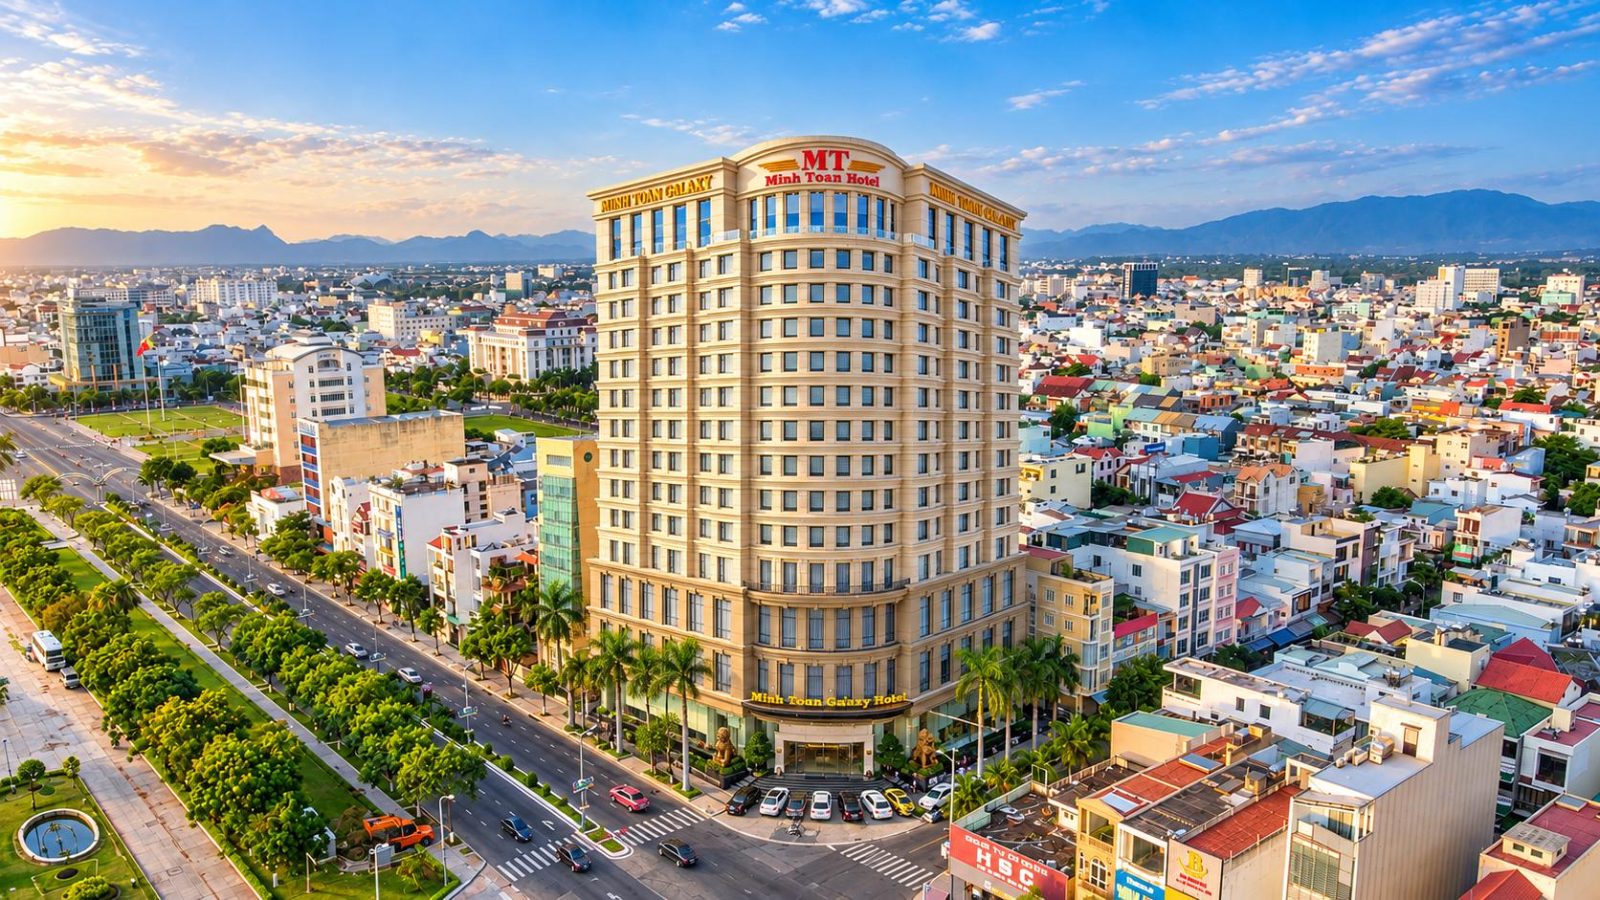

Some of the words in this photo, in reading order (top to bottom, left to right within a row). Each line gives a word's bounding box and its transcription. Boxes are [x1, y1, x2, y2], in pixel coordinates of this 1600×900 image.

[801, 149, 850, 171] MT
[665, 174, 713, 198] GALAXY
[765, 172, 801, 187] Minh
[805, 171, 841, 183] Toan
[846, 172, 880, 188] Hotel
[751, 691, 784, 704] Minh
[788, 695, 823, 707] Toan
[825, 695, 871, 709] Galaxy
[873, 692, 908, 706] Hotel
